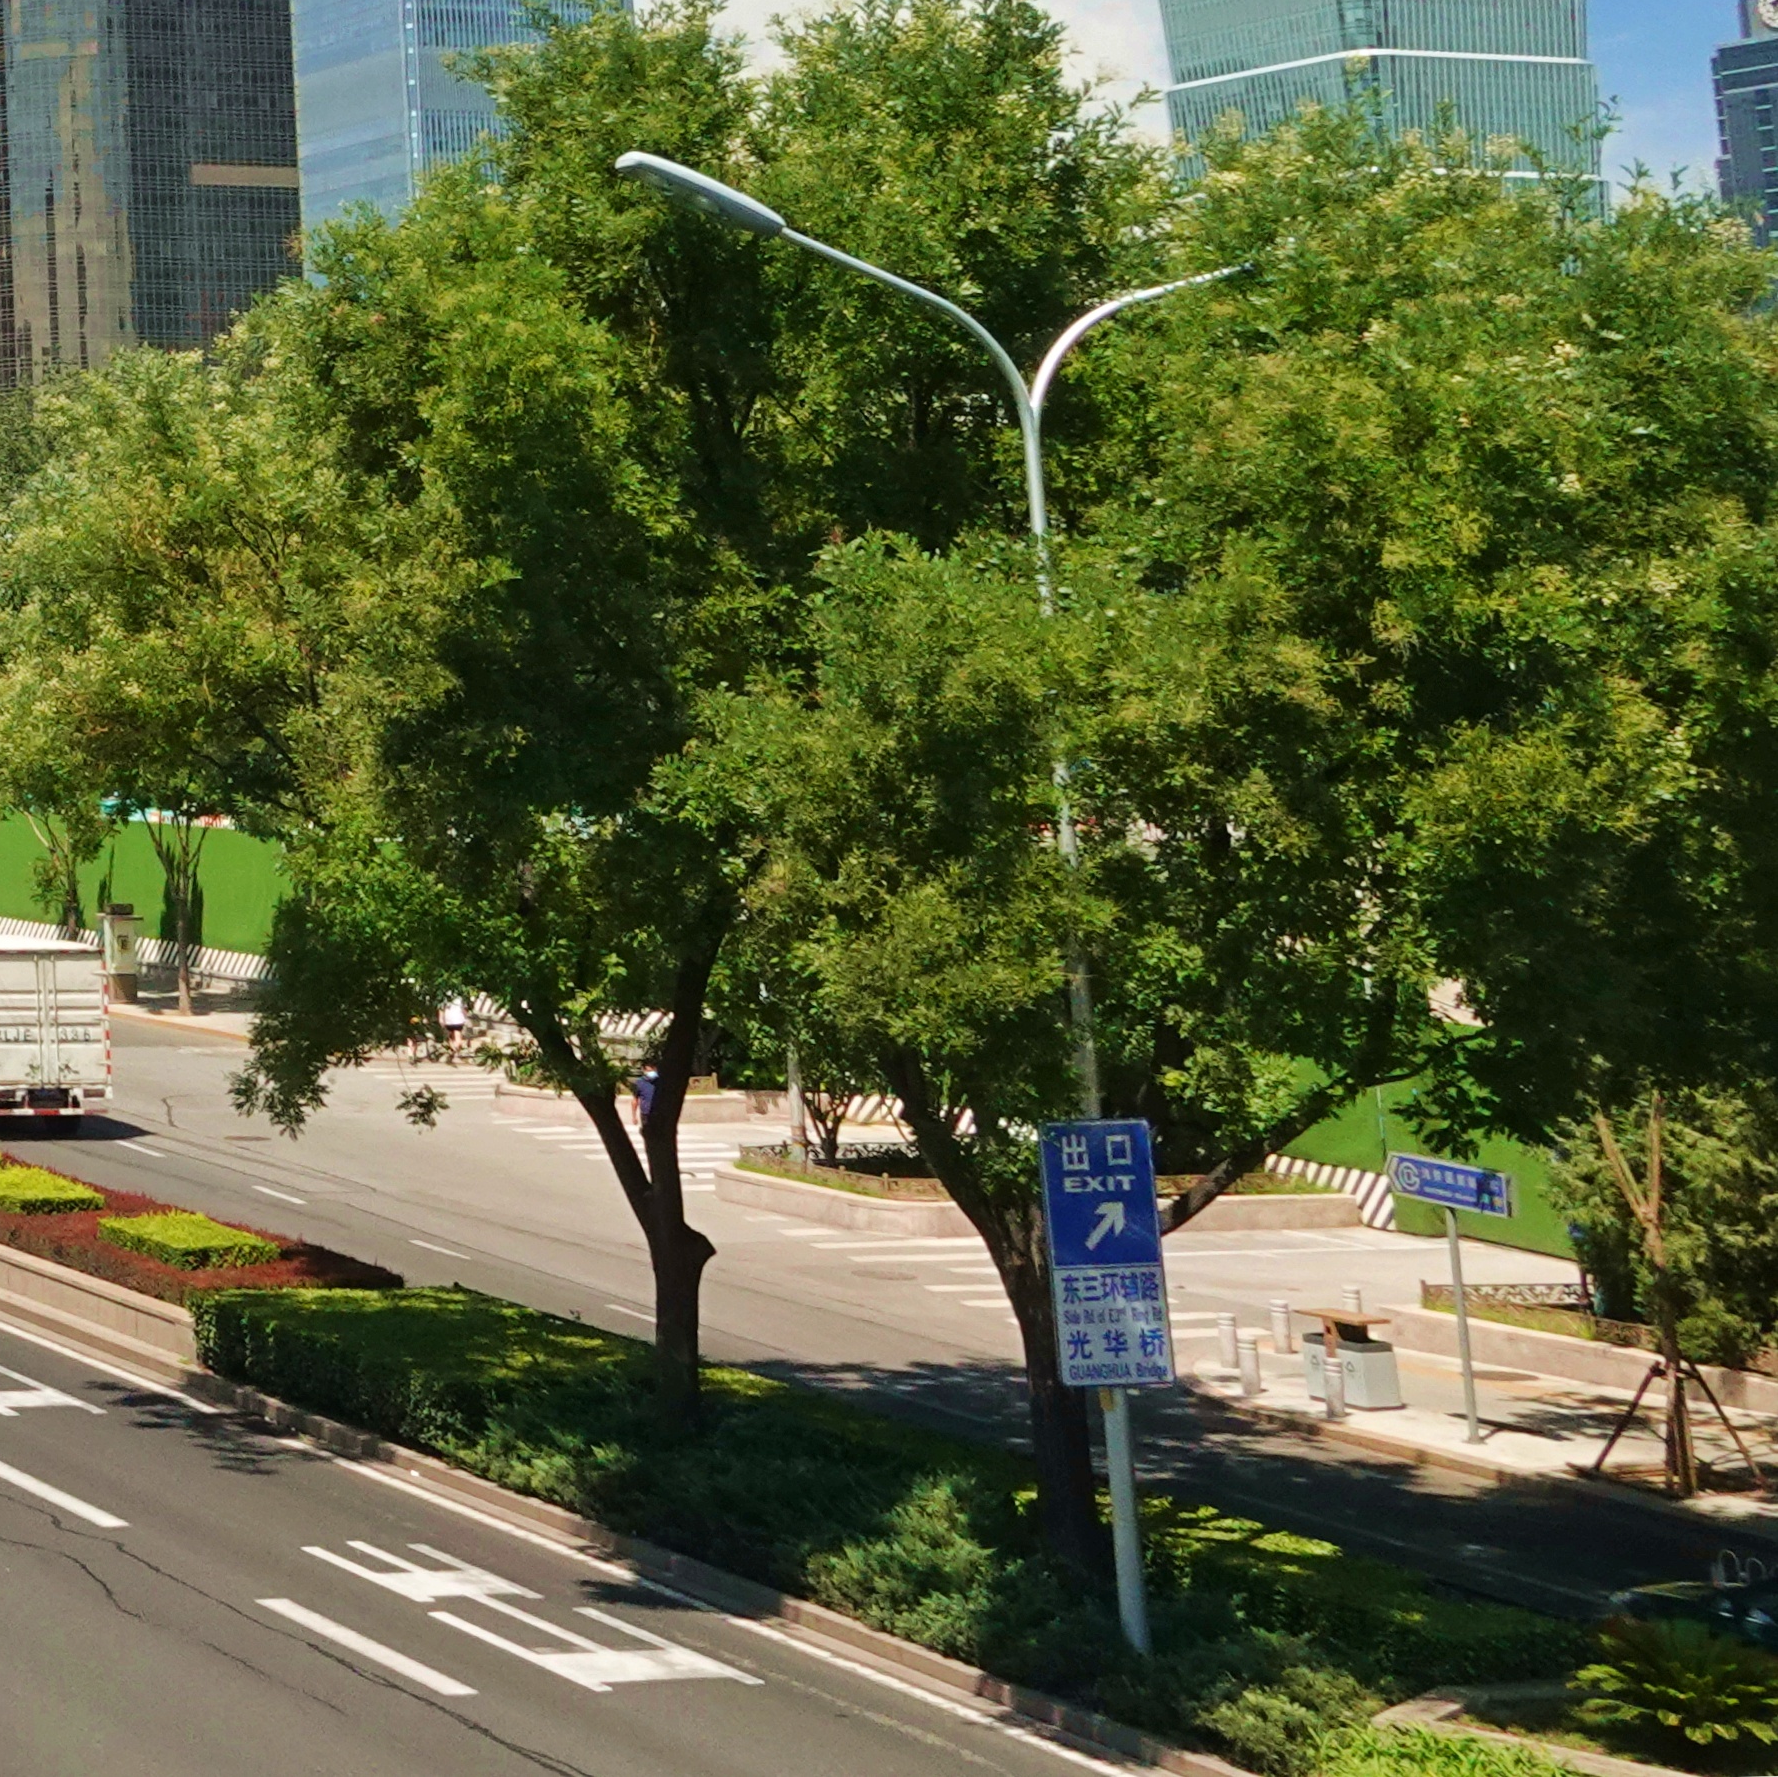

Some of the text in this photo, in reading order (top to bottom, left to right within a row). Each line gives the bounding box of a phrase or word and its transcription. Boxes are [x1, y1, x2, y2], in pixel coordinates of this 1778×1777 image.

[1062, 1133, 1132, 1171] 出口
[1064, 1174, 1136, 1193] EXIT
[1061, 1271, 1159, 1305] 东三环辅路
[1067, 1327, 1165, 1360] 光华桥
